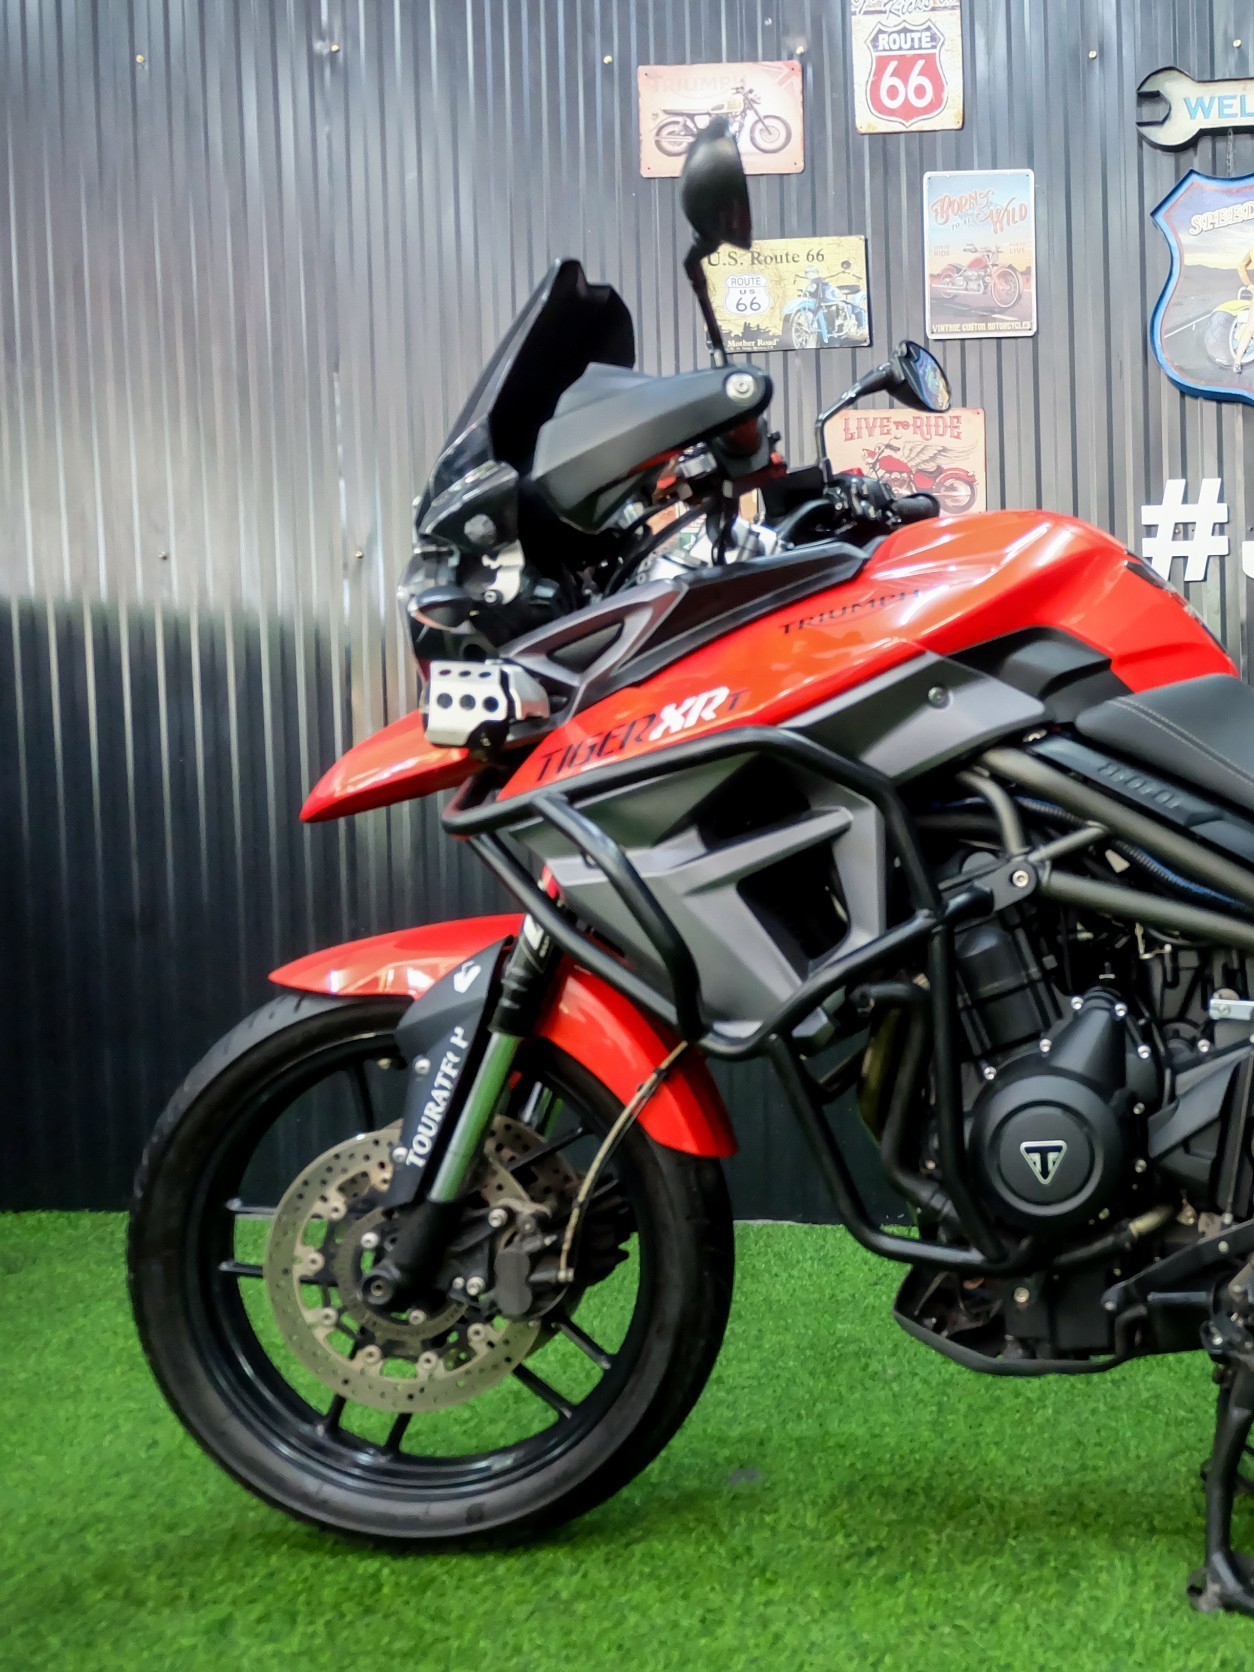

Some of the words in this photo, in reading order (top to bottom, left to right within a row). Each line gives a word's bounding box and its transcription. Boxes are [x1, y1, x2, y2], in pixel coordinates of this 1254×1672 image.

[877, 32, 932, 50] ROUTE
[880, 59, 933, 109] 66
[707, 251, 743, 267] U.S.
[750, 250, 800, 265] Route
[806, 249, 825, 262] 66
[731, 277, 761, 286] ROUTE
[736, 296, 761, 312] 66
[727, 339, 755, 347] Mother
[843, 417, 891, 442] LIVE
[893, 420, 910, 430] TO
[912, 415, 962, 441] RIDE
[778, 588, 922, 635] TRIUMPH
[537, 710, 656, 782] TIGER
